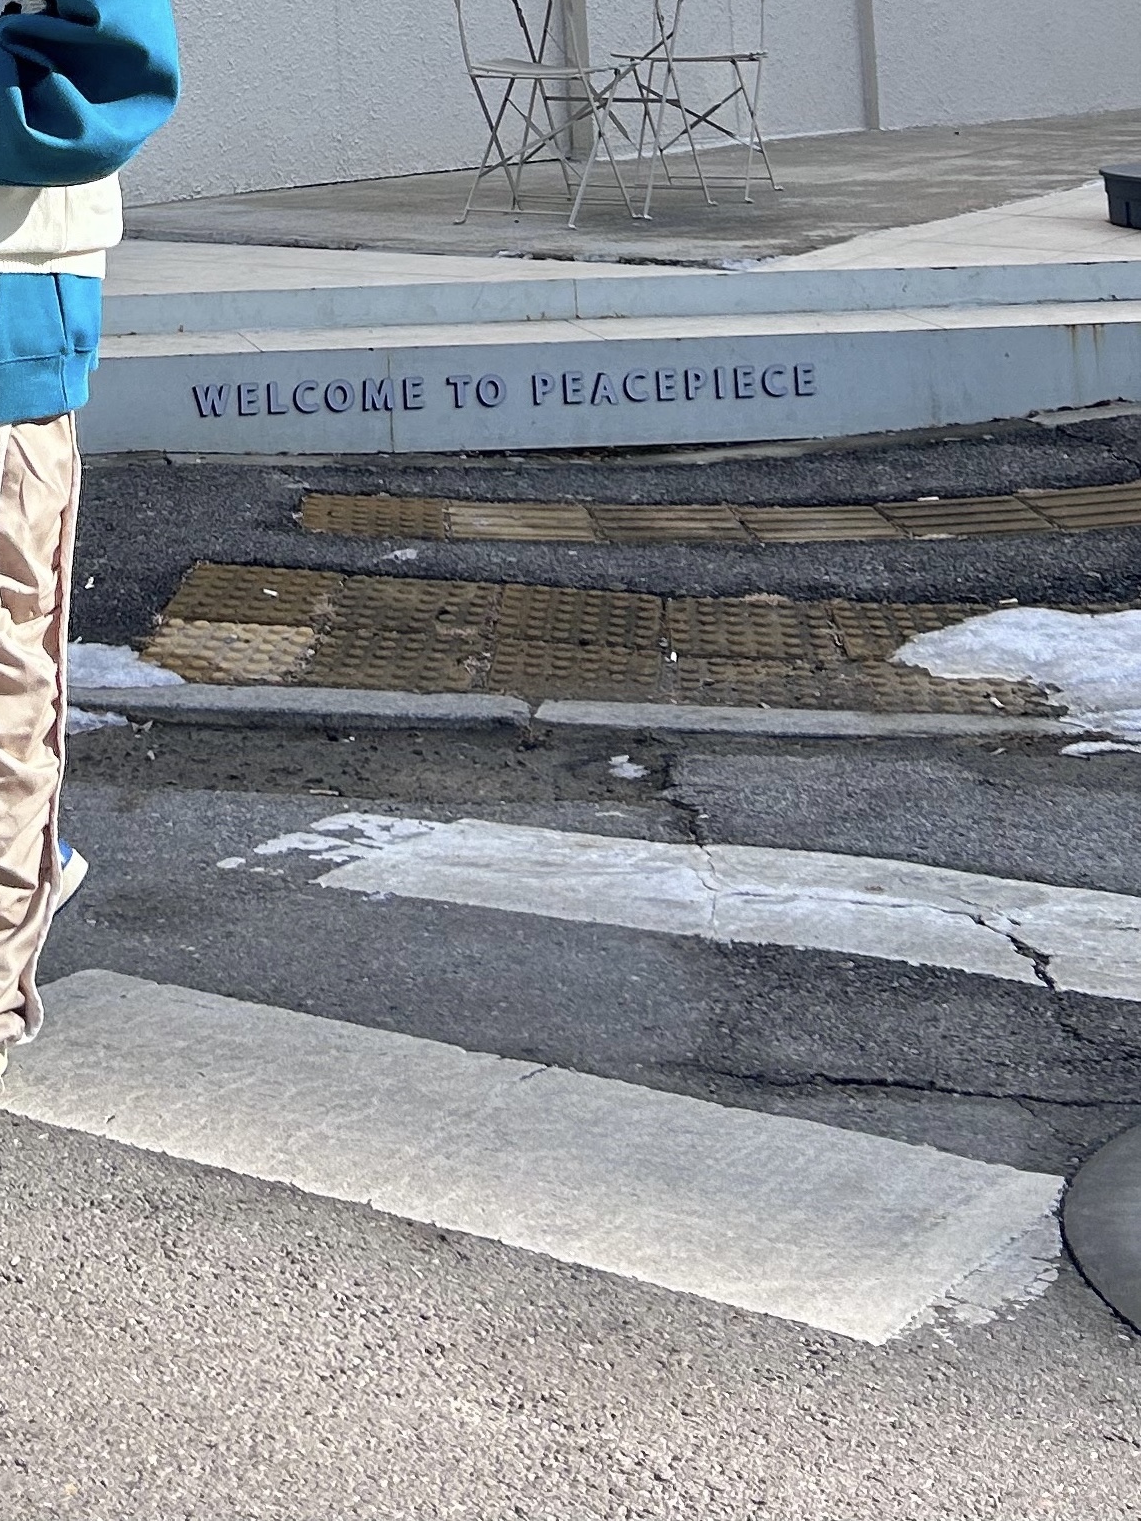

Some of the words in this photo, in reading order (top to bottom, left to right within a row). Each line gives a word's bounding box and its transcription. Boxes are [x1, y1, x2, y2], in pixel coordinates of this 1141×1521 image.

[192, 374, 427, 418] WELCOME
[444, 372, 507, 410] TO
[530, 361, 819, 408] PEACEPIECE
